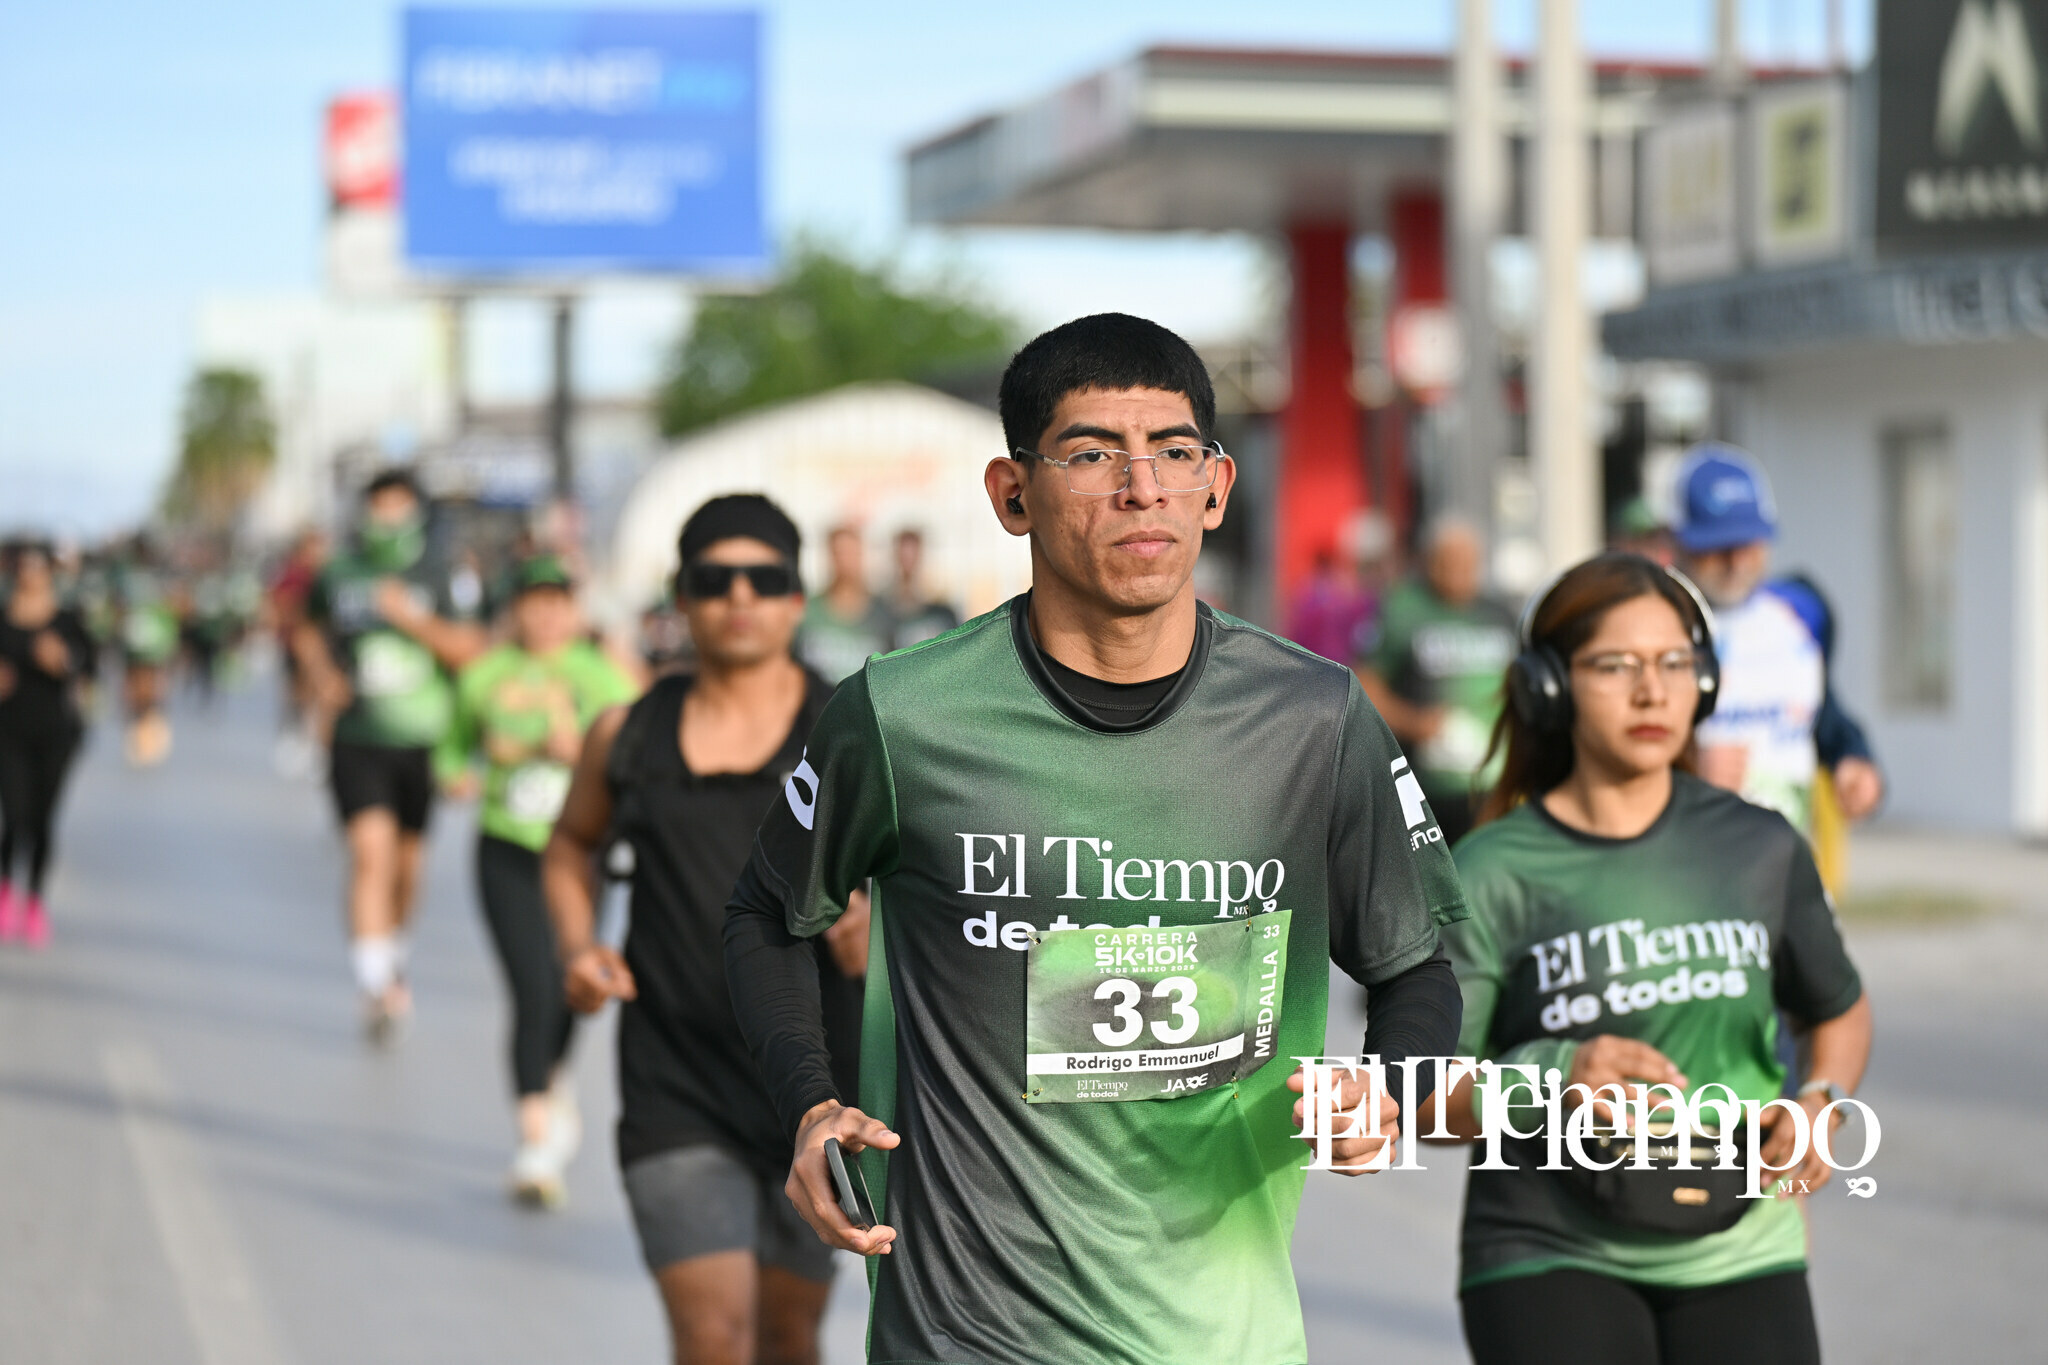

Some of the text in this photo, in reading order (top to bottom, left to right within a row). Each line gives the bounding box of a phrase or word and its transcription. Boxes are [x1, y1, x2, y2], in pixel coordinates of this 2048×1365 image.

[955, 833, 1285, 918] El Tiempo
[962, 911, 1037, 950] de
[1094, 931, 1198, 946] CARRERA
[1263, 925, 1280, 939] 33
[1531, 918, 1769, 992] El Tiempo
[1092, 976, 1200, 1047] 33
[1254, 949, 1279, 1058] MEDALLA
[1540, 965, 1748, 1031] de todos
[1066, 1045, 1220, 1071] Rodrigo Emmanuel
[1076, 1091, 1089, 1099] de
[1077, 1080, 1128, 1092] El Tiempo
